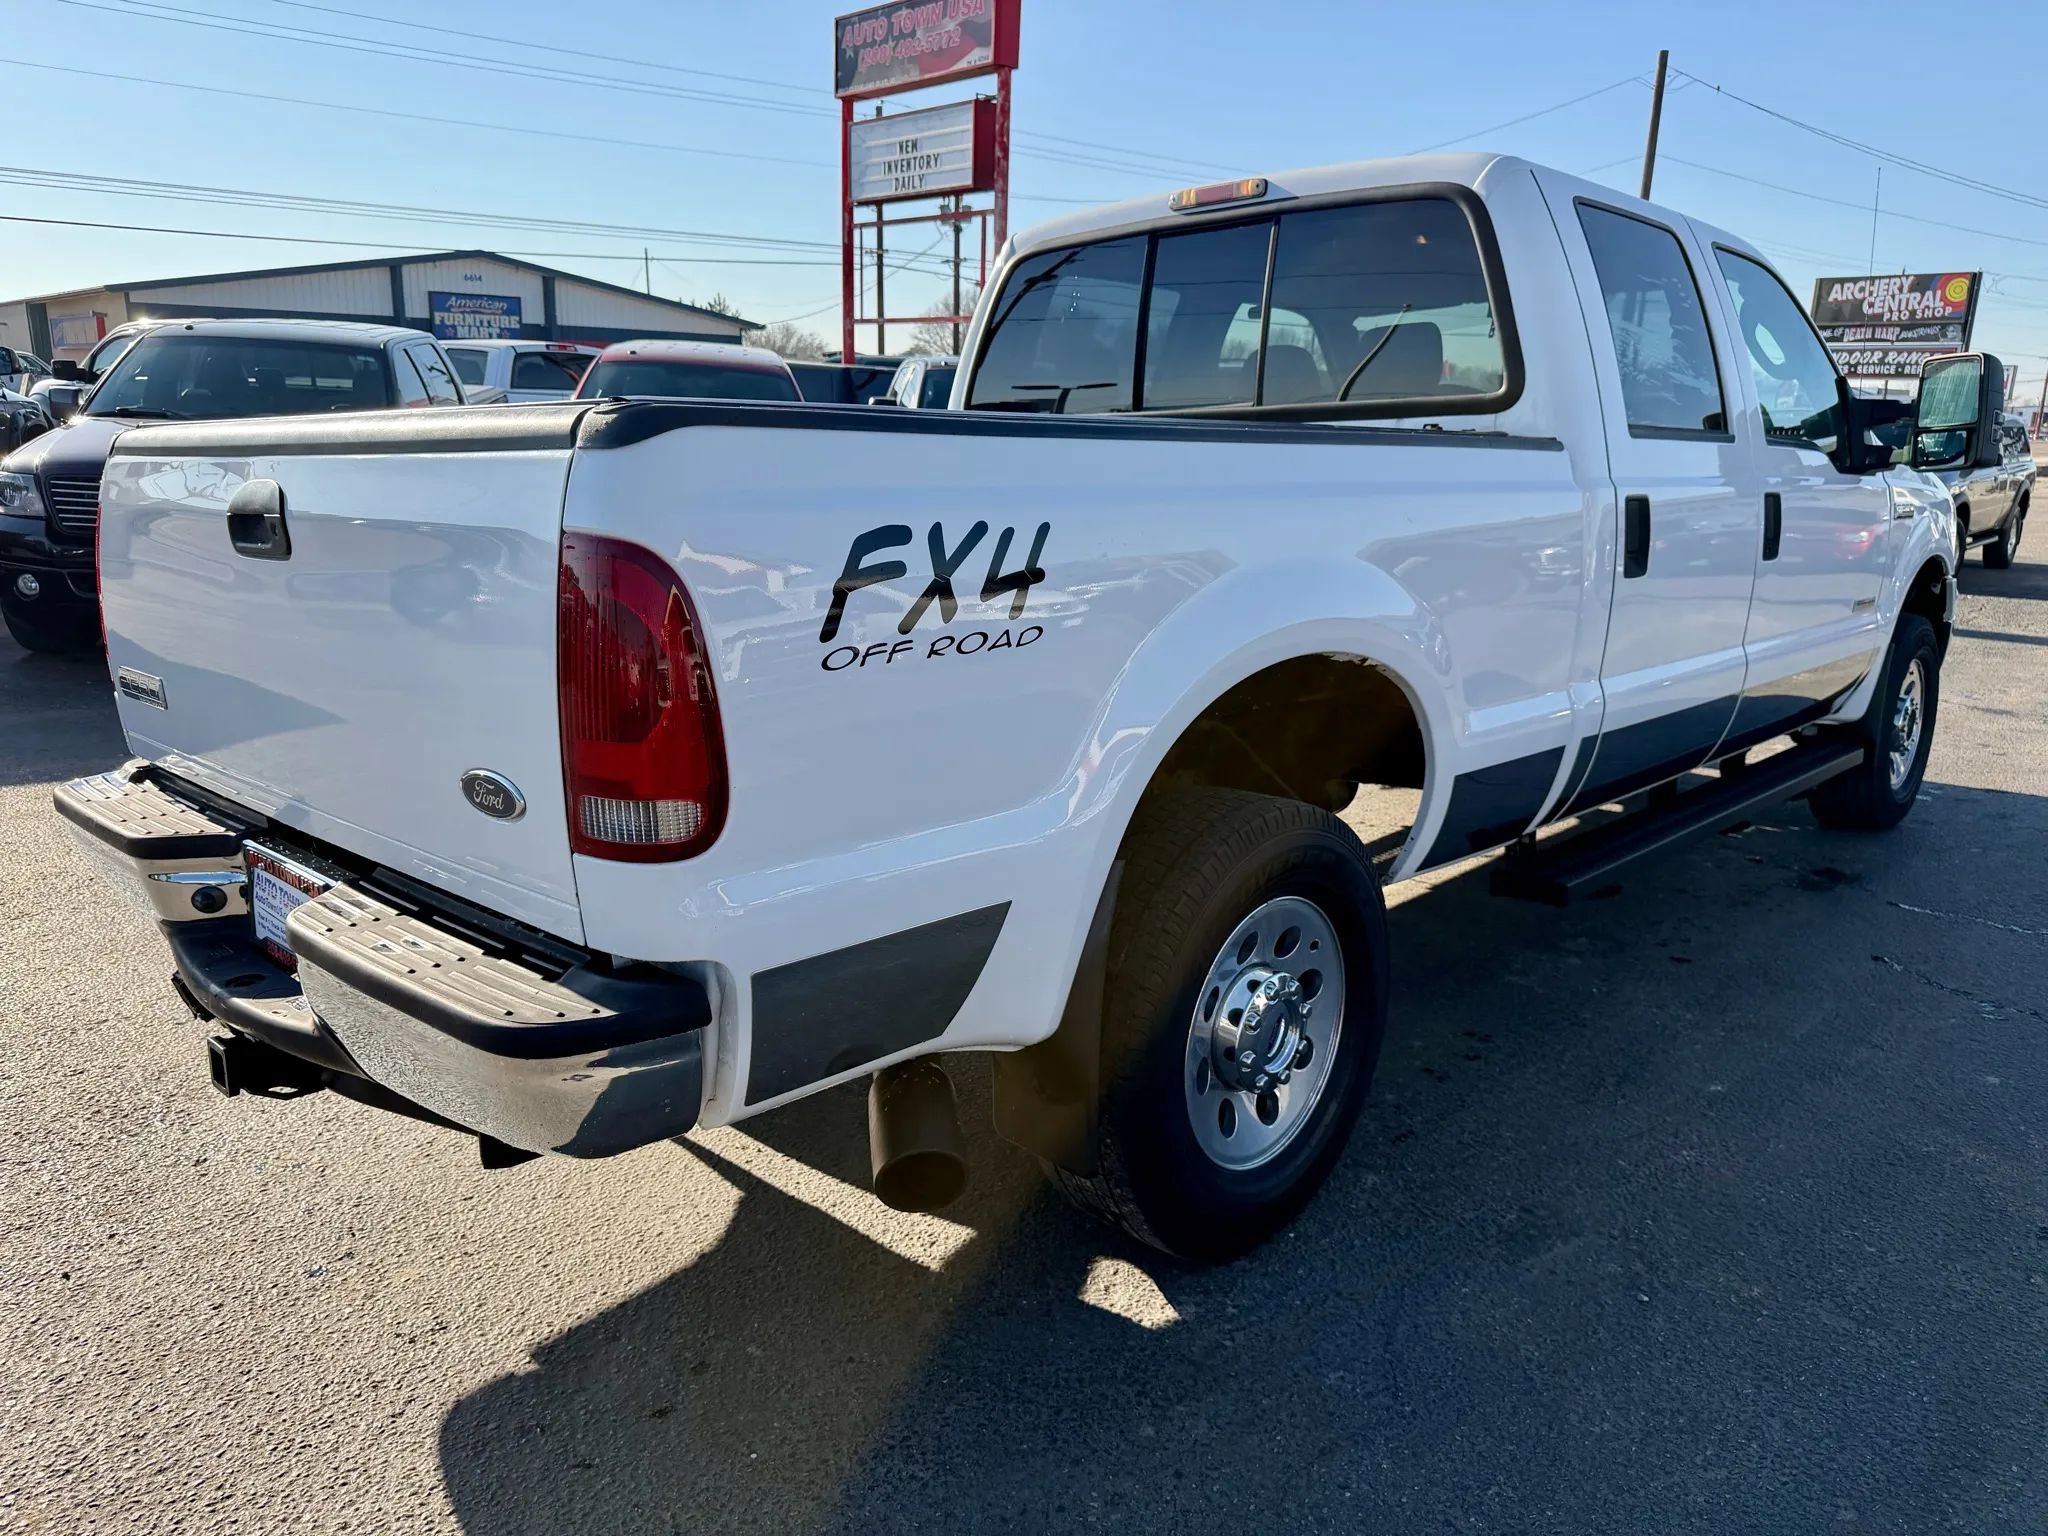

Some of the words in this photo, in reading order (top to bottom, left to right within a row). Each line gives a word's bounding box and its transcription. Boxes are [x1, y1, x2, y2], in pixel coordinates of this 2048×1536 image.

[842, 17, 888, 48] AUTO
[891, 1, 944, 36] TOWN
[947, 0, 985, 21] USA
[883, 153, 940, 176] INVENTORY
[894, 174, 925, 192] DAILY
[1828, 276, 1915, 302] ARCHERY
[446, 297, 507, 310] American
[1862, 289, 1944, 315] CENTRAL
[434, 312, 520, 329] FURNITURE
[1883, 310, 1909, 322] PRO
[1915, 306, 1952, 319] SHOP
[456, 325, 500, 339] MART
[1844, 327, 1872, 342] DEATH
[1875, 327, 1900, 342] HARP
[1832, 351, 1883, 365] NDOOR
[1885, 351, 1942, 365] RANG
[1857, 364, 1896, 375] SERVICE
[819, 520, 1050, 643] FX4
[821, 639, 914, 671] OFF
[927, 625, 1044, 659] ROAD
[473, 780, 504, 810] Ford
